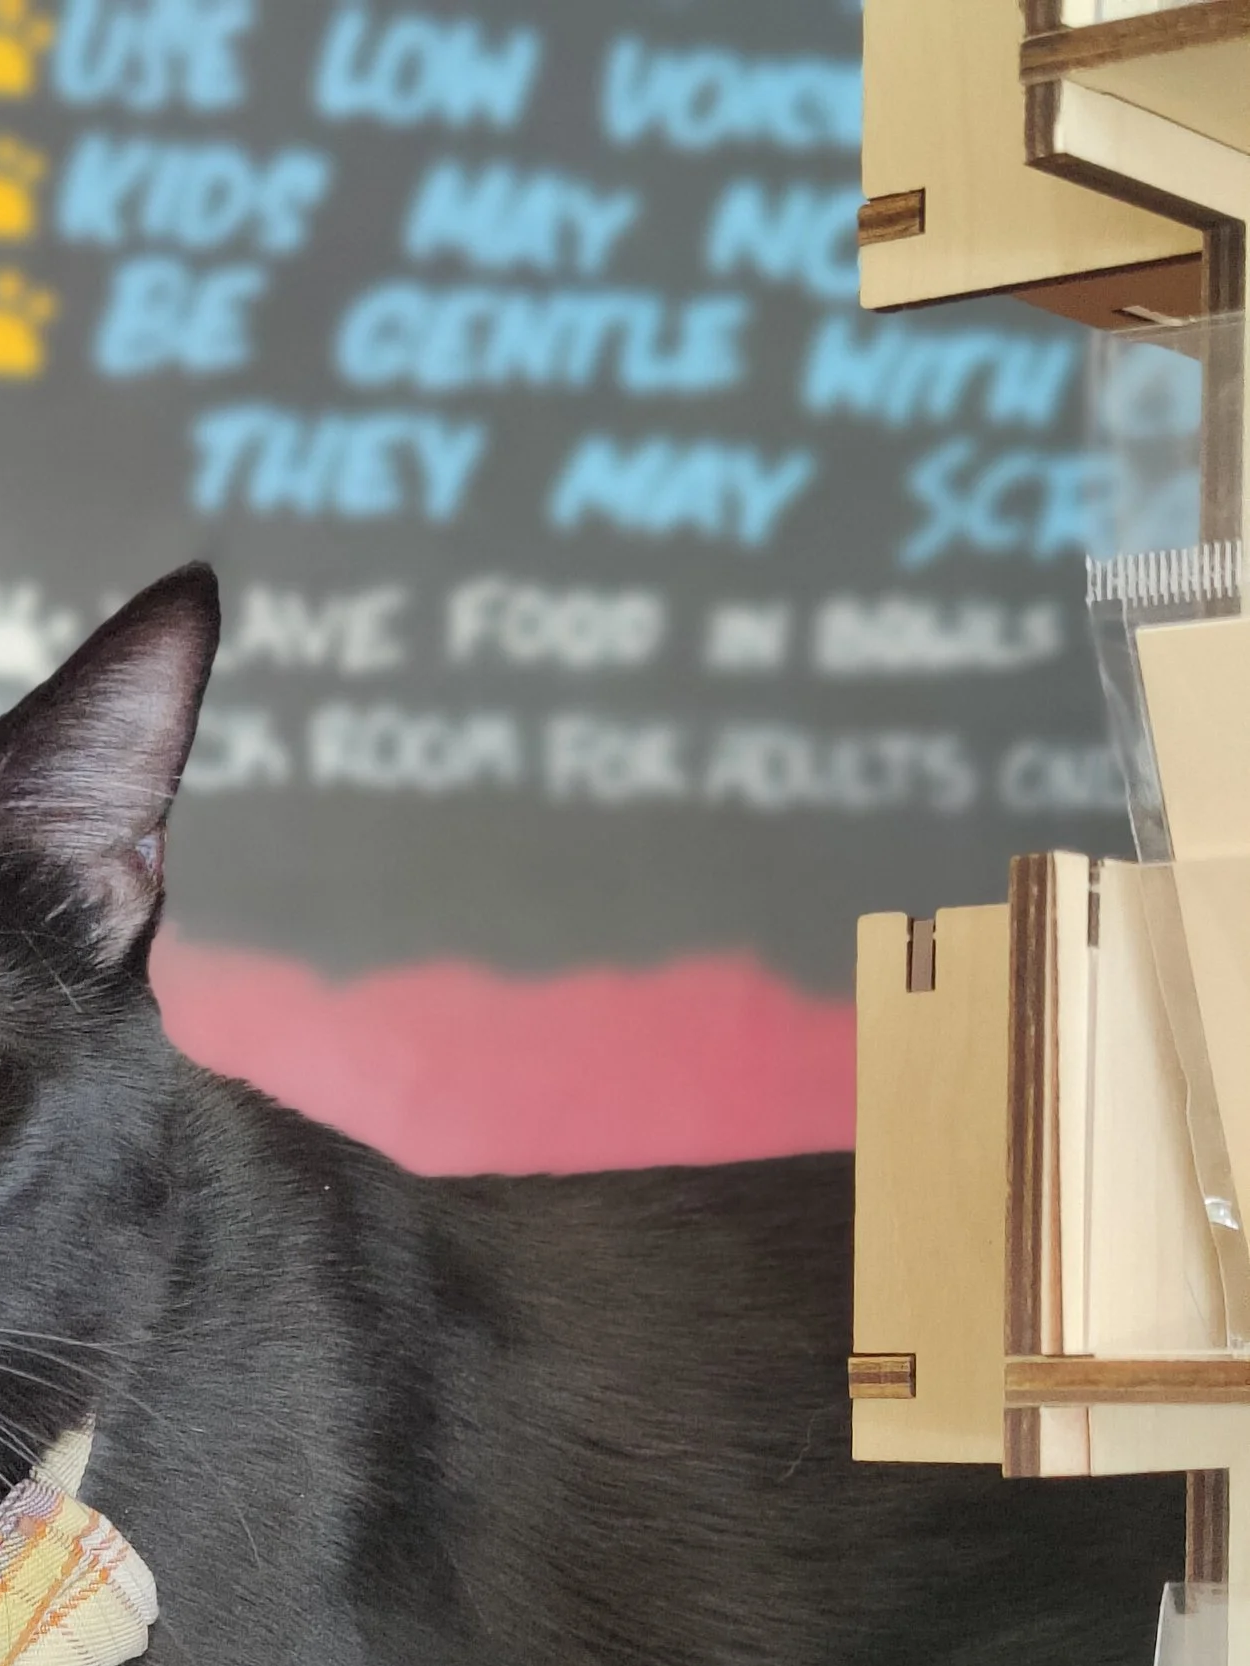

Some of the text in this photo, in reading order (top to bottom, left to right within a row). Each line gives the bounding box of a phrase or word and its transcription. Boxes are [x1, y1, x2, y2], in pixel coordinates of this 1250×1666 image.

[52, 0, 252, 112] USE
[316, 8, 540, 126] LOW
[56, 134, 332, 256] KIDS
[406, 158, 638, 276] MAY
[96, 260, 266, 376] BE
[338, 282, 748, 394] GENTLE
[804, 318, 1074, 430] WITH
[190, 408, 486, 524] THEY
[550, 436, 814, 548] MAY
[446, 576, 662, 670] FOOD
[306, 706, 518, 790] ROOM
[546, 712, 686, 800] FOR
